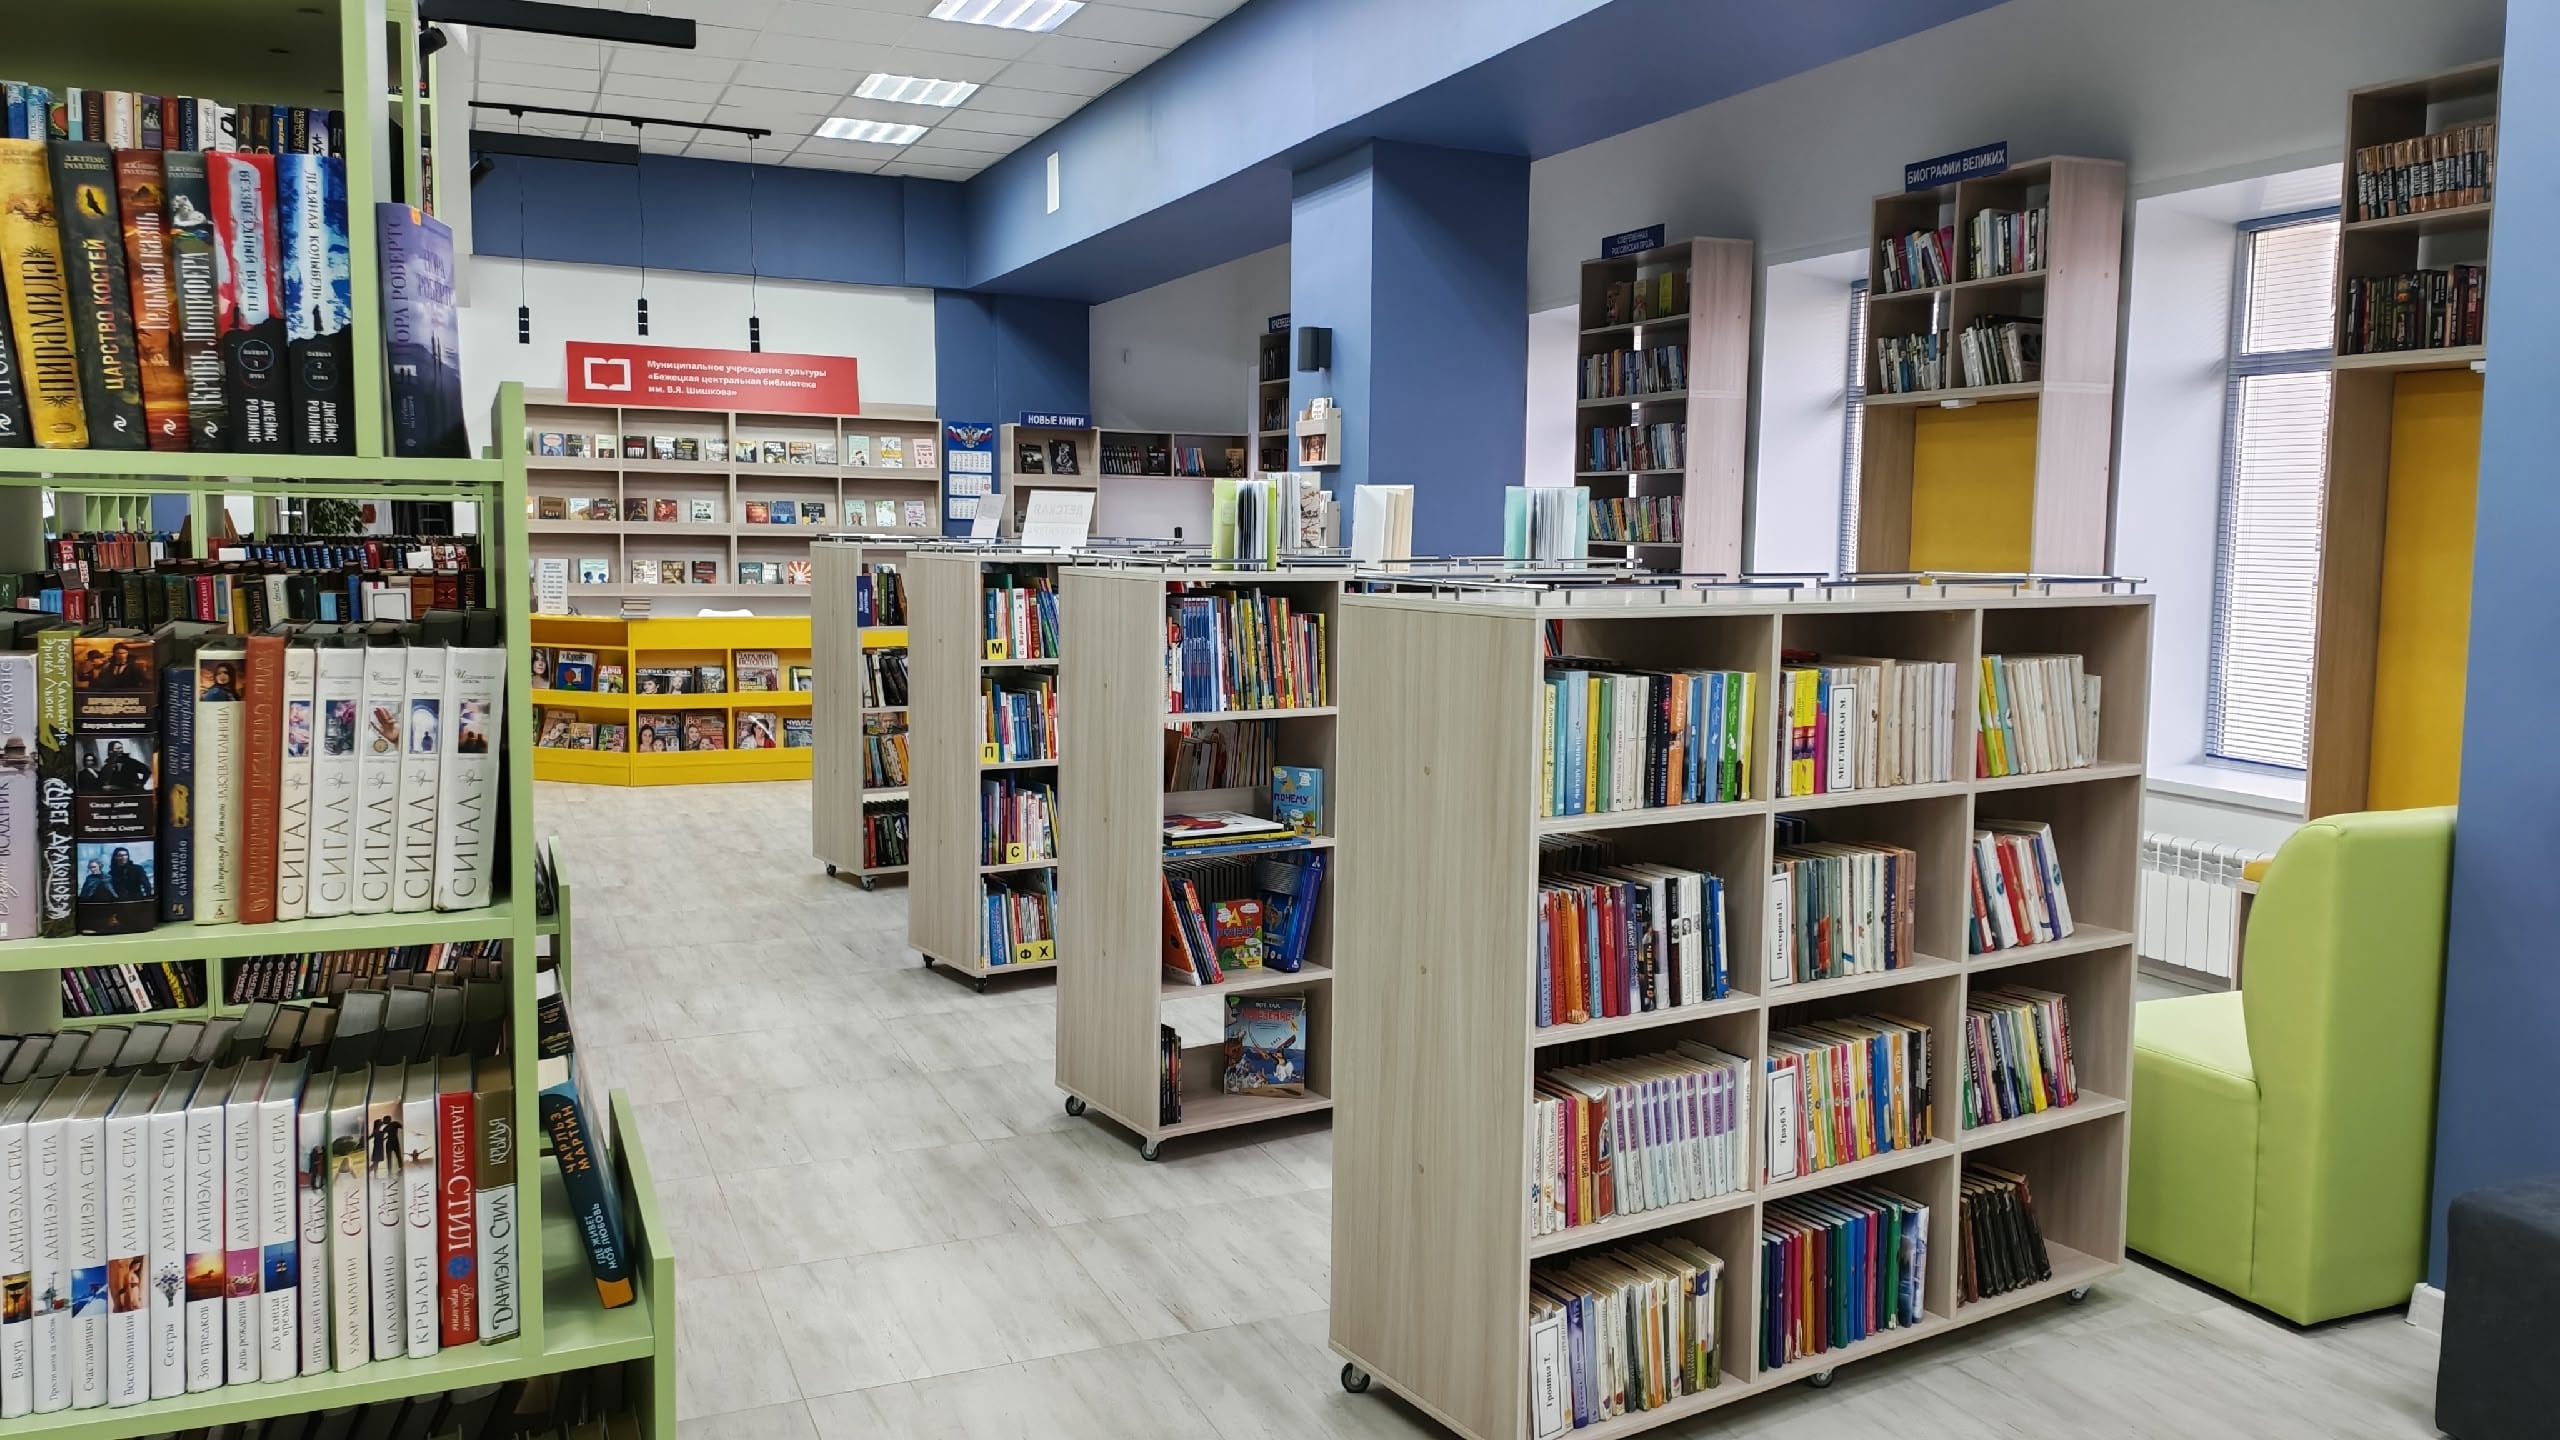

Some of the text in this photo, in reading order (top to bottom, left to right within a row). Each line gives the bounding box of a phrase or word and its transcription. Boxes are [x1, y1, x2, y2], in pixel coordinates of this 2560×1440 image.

[1907, 148, 2005, 185] БИОГРАФИИ ВЕЛИКИХ
[303, 169, 324, 300] ЛЕДЯНАЯ КОЛЫБЕЛЬ
[82, 239, 125, 391] ЦАРСТВО КОСТЕЙ
[247, 269, 260, 313] ВЕНЕЦ
[647, 359, 827, 378] Муниципальное учреждение культуры
[685, 387, 738, 397] Шишкова»
[701, 375, 762, 386] центральная
[762, 377, 817, 389] библиотека
[246, 398, 261, 444] РОЛЛИНС
[262, 398, 279, 443] ДЖЕЙМС
[307, 399, 323, 445] РОЛЛИНС
[323, 400, 338, 444] ДЖЕЙМС
[1028, 414, 1085, 427] НОВЫЕ КНИГИ
[43, 638, 56, 720] Эрика Льюис
[992, 643, 1003, 654] М
[2, 661, 14, 735] САЙМОНС
[54, 638, 70, 748] Роберт Сальваторе
[985, 746, 994, 758] П
[1837, 709, 1847, 782] МЕТЛИЦКАЯ
[170, 853, 180, 887] ДЖИЛЛ
[178, 839, 188, 897] САНТОПОЛО
[282, 798, 307, 906] СИГАЛ
[320, 796, 350, 902] СИГАЛ
[362, 796, 393, 901] СИГАЛ
[404, 794, 435, 899] СИГАЛ
[452, 793, 482, 898] СИГАЛ
[1011, 846, 1020, 858] С
[1227, 908, 1242, 928] А
[1776, 912, 1785, 960] Нестерова
[1020, 946, 1049, 960] Ф Х
[550, 1111, 574, 1175] ЧАРЛЬЗ
[564, 1104, 591, 1171] МАРТИН
[1778, 1118, 1787, 1146] Трауб
[7, 1136, 24, 1265] ДАНИЭЛА СТИЛ
[42, 1134, 59, 1261] ДАНИЭЛА СТИЛ
[79, 1134, 97, 1260] ДАНИЭЛА СТИЛ
[121, 1126, 137, 1251] ДАНИЭЛА СТИЛ
[160, 1127, 176, 1252] ДАНИЭЛА СТИЛ
[195, 1122, 212, 1243] ДАНИЭЛА СТИЛ
[234, 1119, 249, 1243] ДАНИЭЛА СТИЛ
[270, 1112, 287, 1235] ДАНИЭЛА СТИЛ
[447, 1104, 472, 1252] ДАНИЭЛА СТИЛ
[489, 1192, 513, 1330] ДАНИЭЛА СТИЛ
[592, 1202, 617, 1270] МОЯ ЛЮБОВЬ
[269, 1297, 281, 1352] До конца
[415, 1255, 430, 1345] КРЫЛЬЯ
[11, 1340, 25, 1380] Выкуп
[123, 1314, 136, 1396] Воспоминания
[163, 1323, 175, 1367] Сестры
[197, 1358, 210, 1381] Зов
[1545, 1364, 1555, 1409] Тронина
